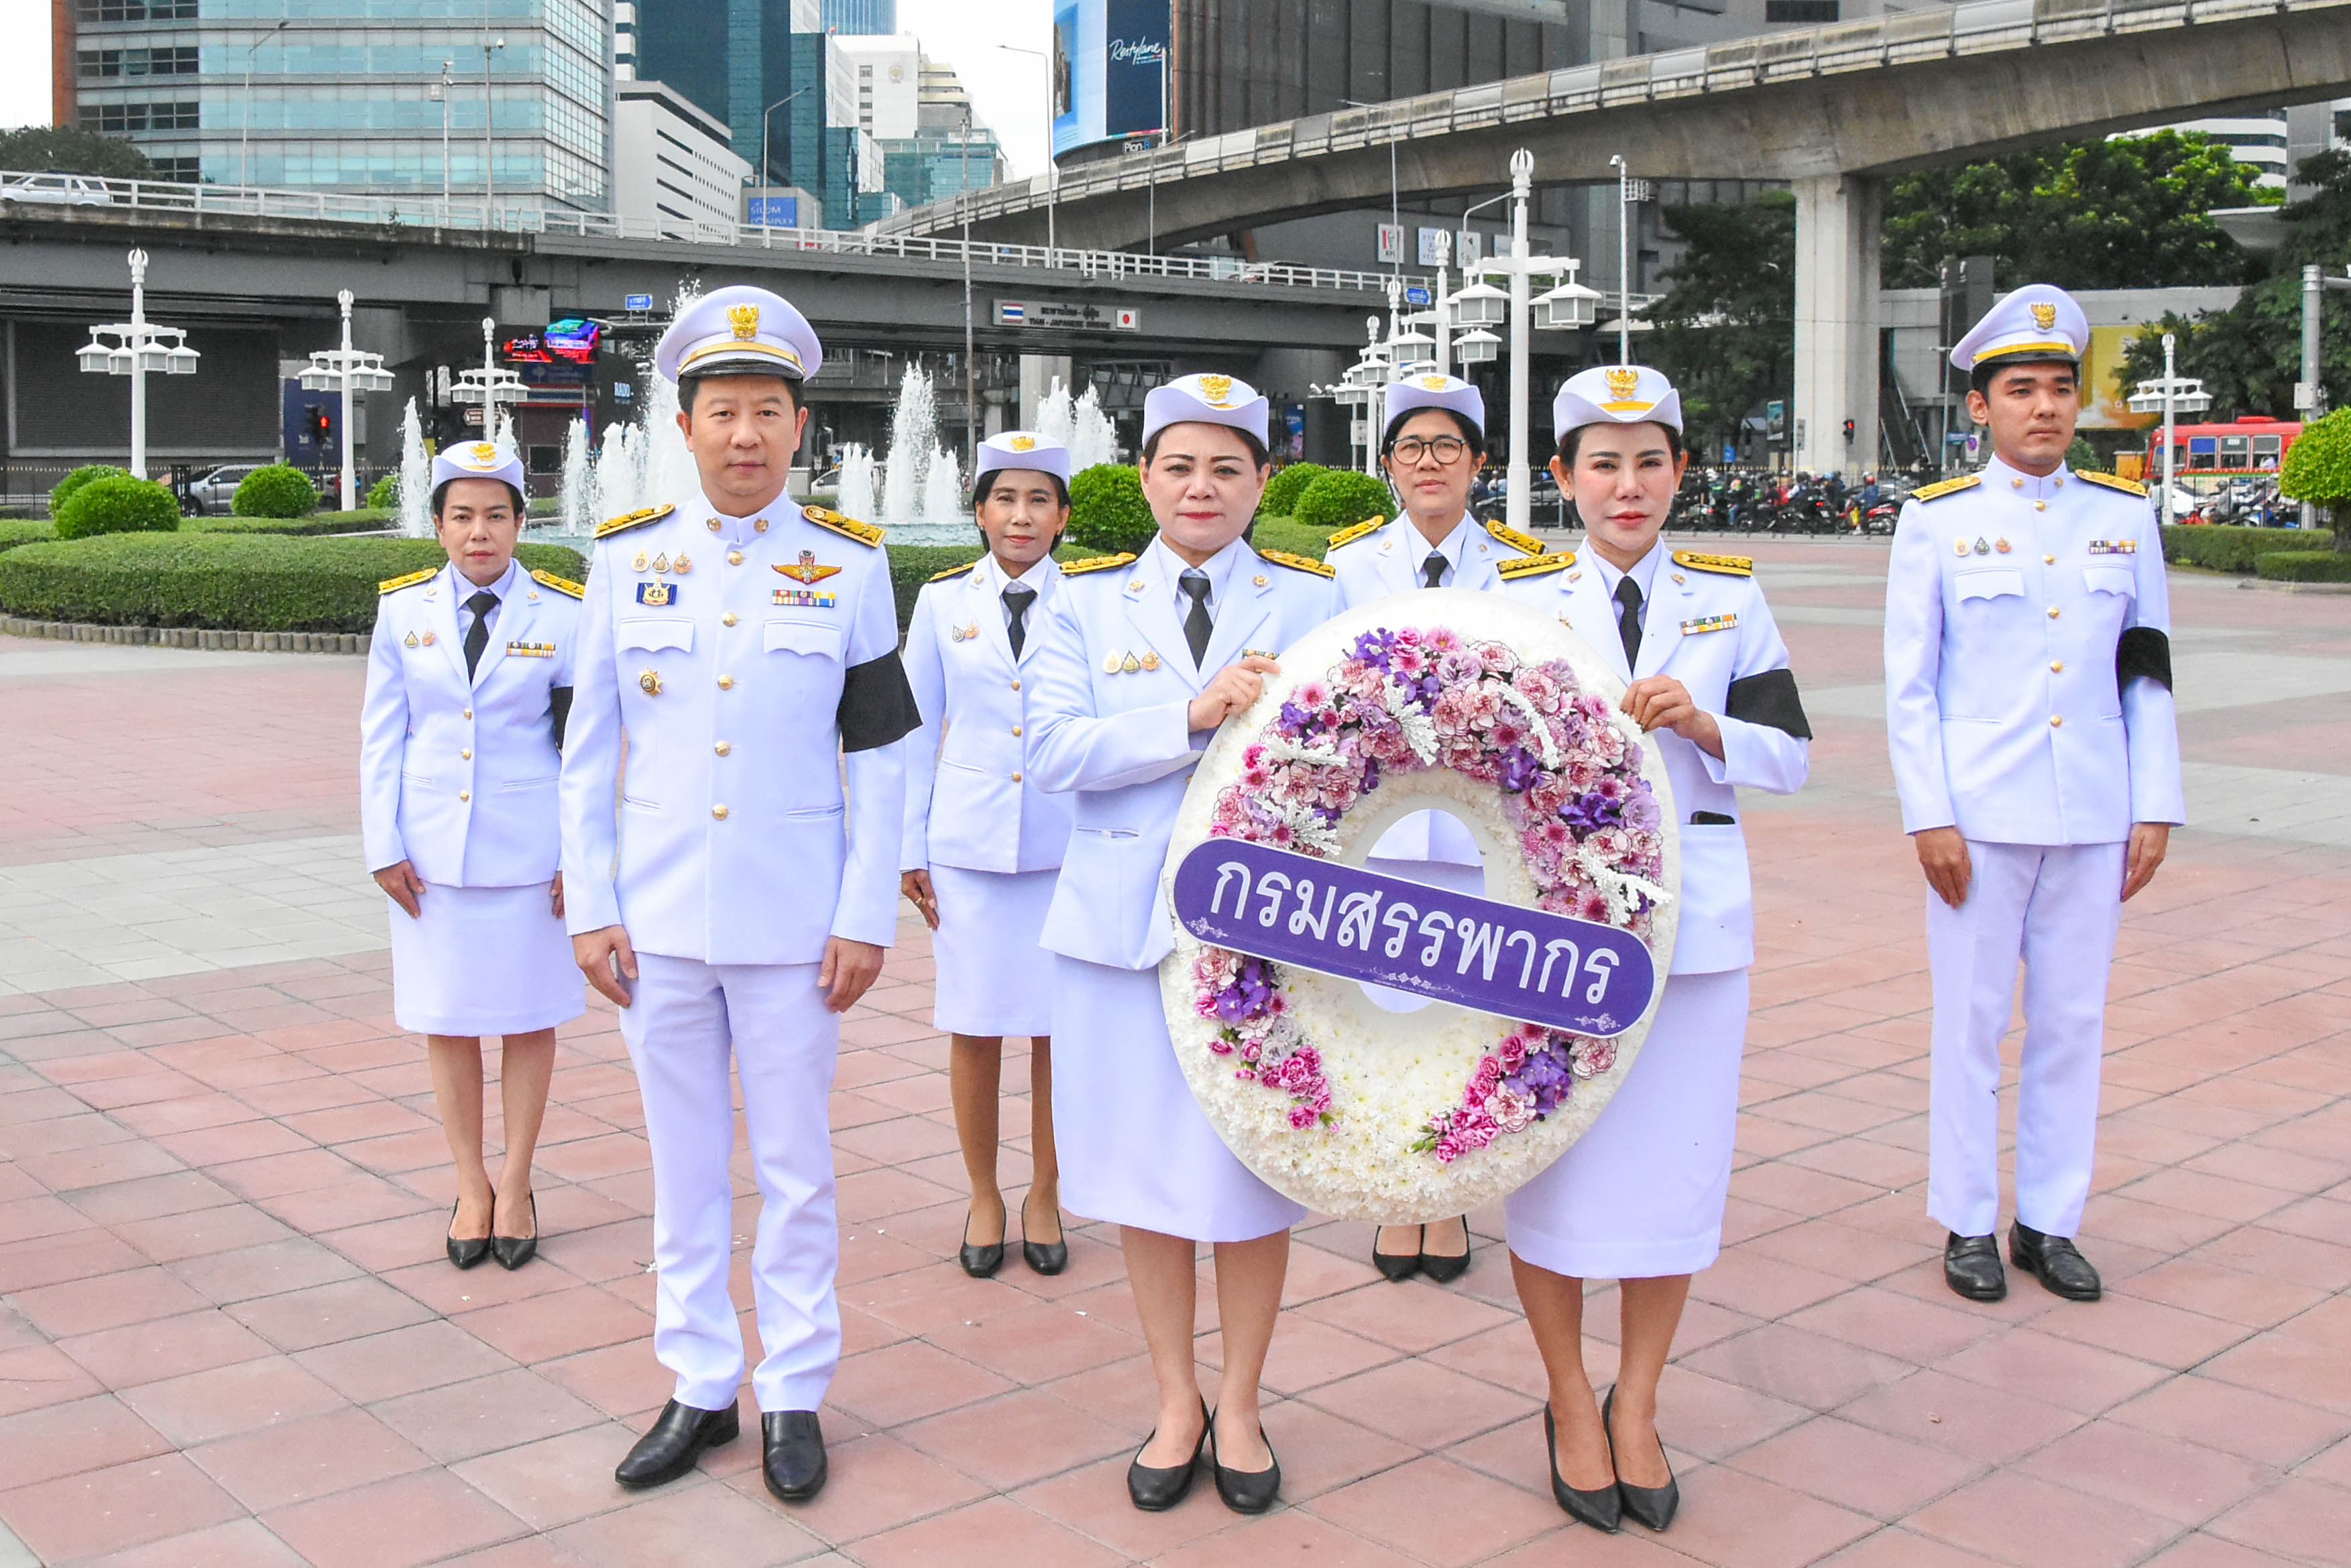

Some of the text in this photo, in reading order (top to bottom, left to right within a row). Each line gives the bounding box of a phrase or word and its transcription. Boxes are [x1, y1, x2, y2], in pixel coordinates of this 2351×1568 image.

[1109, 36, 1161, 66] Restylane
[1124, 141, 1143, 154] Plan
[614, 381, 631, 398] RADO
[1210, 861, 1621, 1005] กรมสรรพากร
